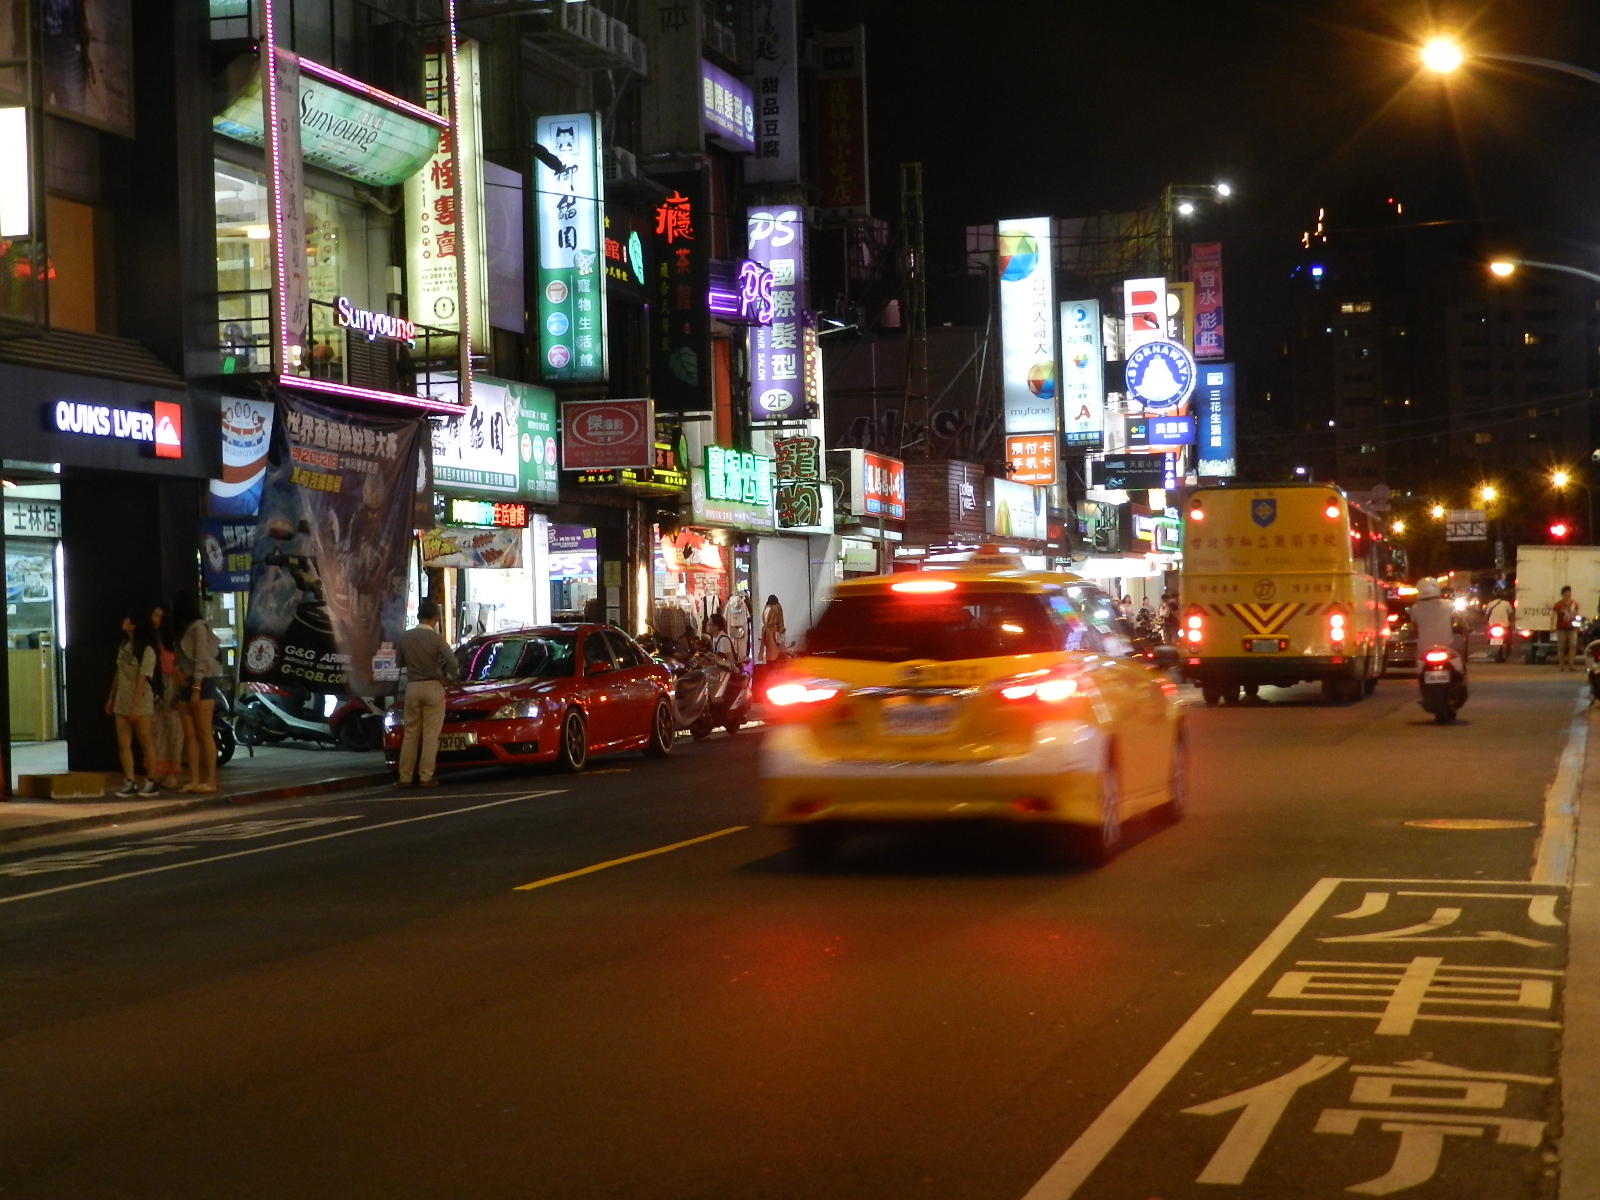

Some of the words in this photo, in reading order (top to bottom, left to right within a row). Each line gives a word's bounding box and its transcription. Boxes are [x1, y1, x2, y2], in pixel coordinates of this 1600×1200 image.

[704, 77, 744, 126] 國際髮型
[762, 77, 780, 158] 甜品豆腐
[299, 89, 379, 153] Sunyoung
[749, 210, 798, 250] PS
[337, 296, 415, 349] Sunyoung
[577, 278, 593, 367] 寵物生活館
[770, 259, 798, 381] 國際髮型
[757, 329, 766, 350] HAIR
[757, 352, 766, 381] SALON
[1127, 344, 1188, 377] STORNAWAY
[767, 393, 788, 408] 2F
[1010, 406, 1051, 418] myfone
[708, 446, 770, 506] 寵物公園
[774, 435, 821, 526] 寵物
[1011, 474, 1036, 482] Prepaid
[1036, 472, 1052, 480] Card
[12, 503, 57, 534] 士林店
[1257, 582, 1271, 597] 27
[284, 645, 316, 660] G&G
